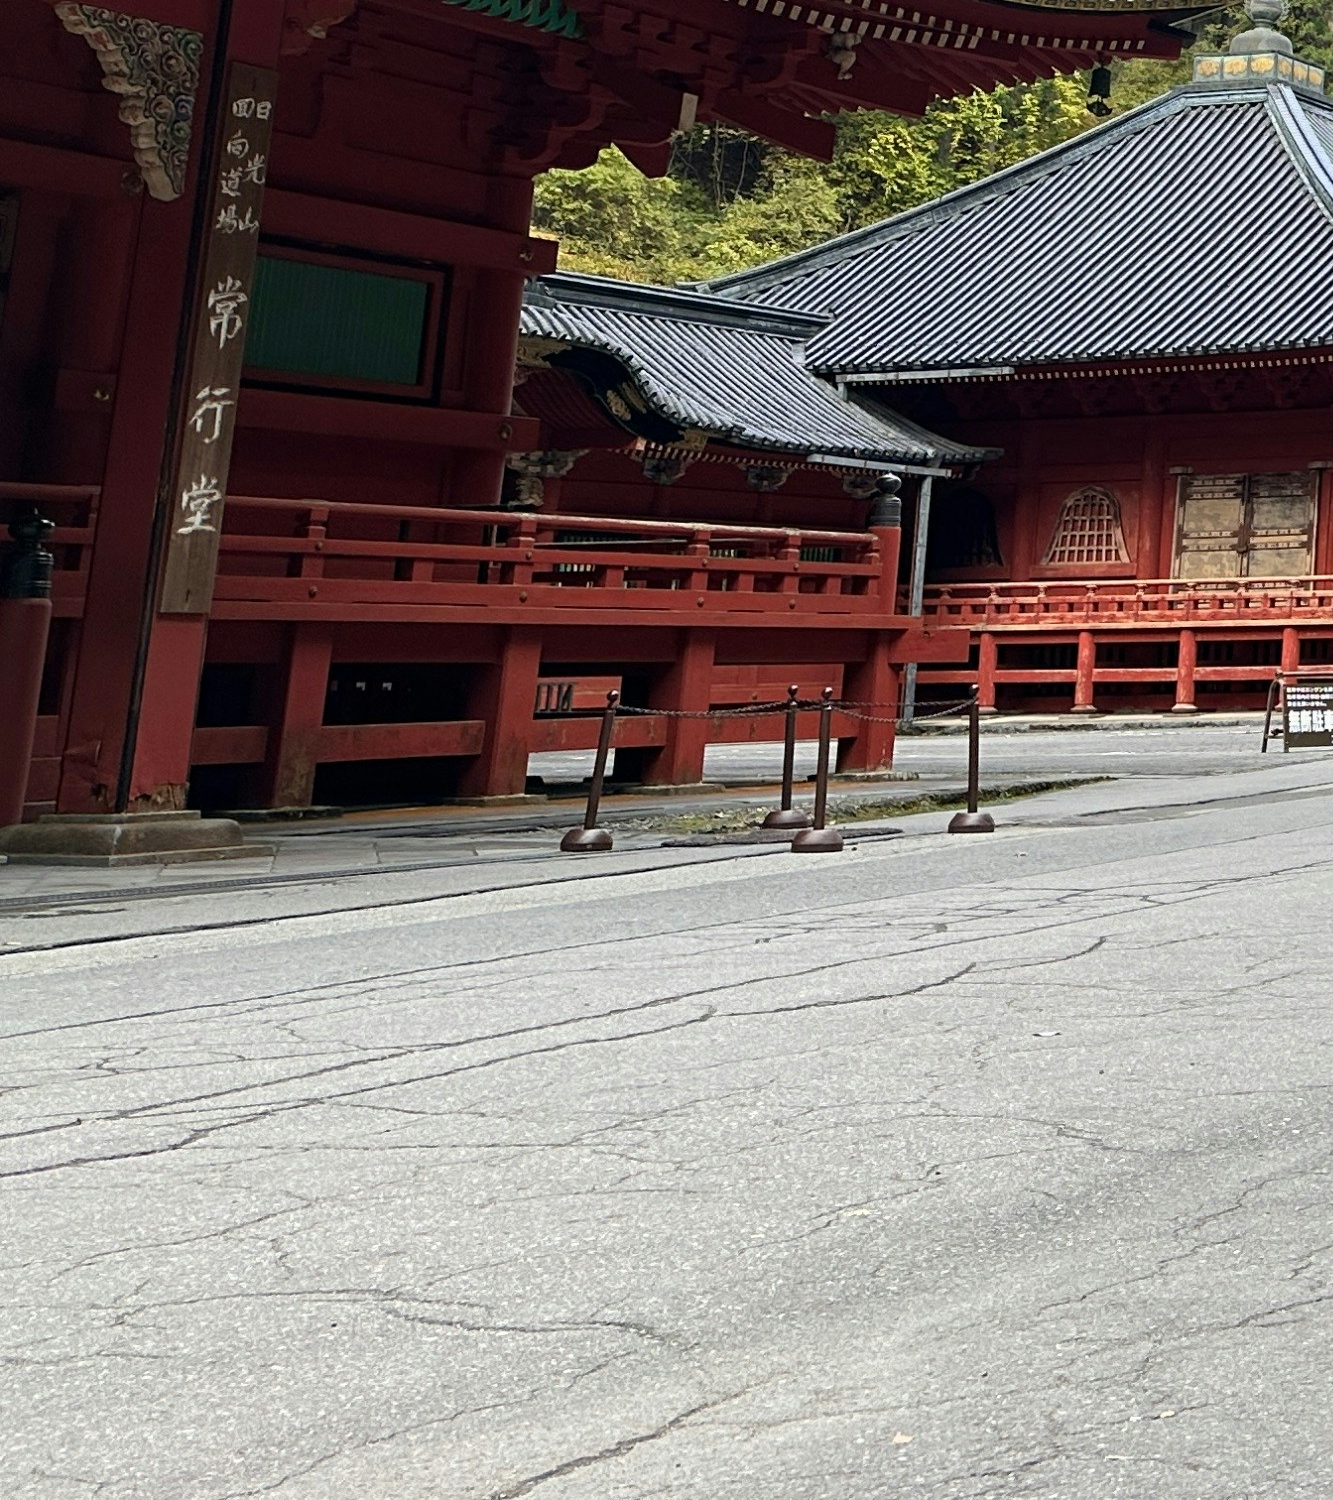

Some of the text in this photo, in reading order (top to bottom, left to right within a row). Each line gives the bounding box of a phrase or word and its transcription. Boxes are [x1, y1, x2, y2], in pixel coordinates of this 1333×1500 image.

[239, 100, 272, 234] 日光山
[176, 274, 248, 535] 常行堂
